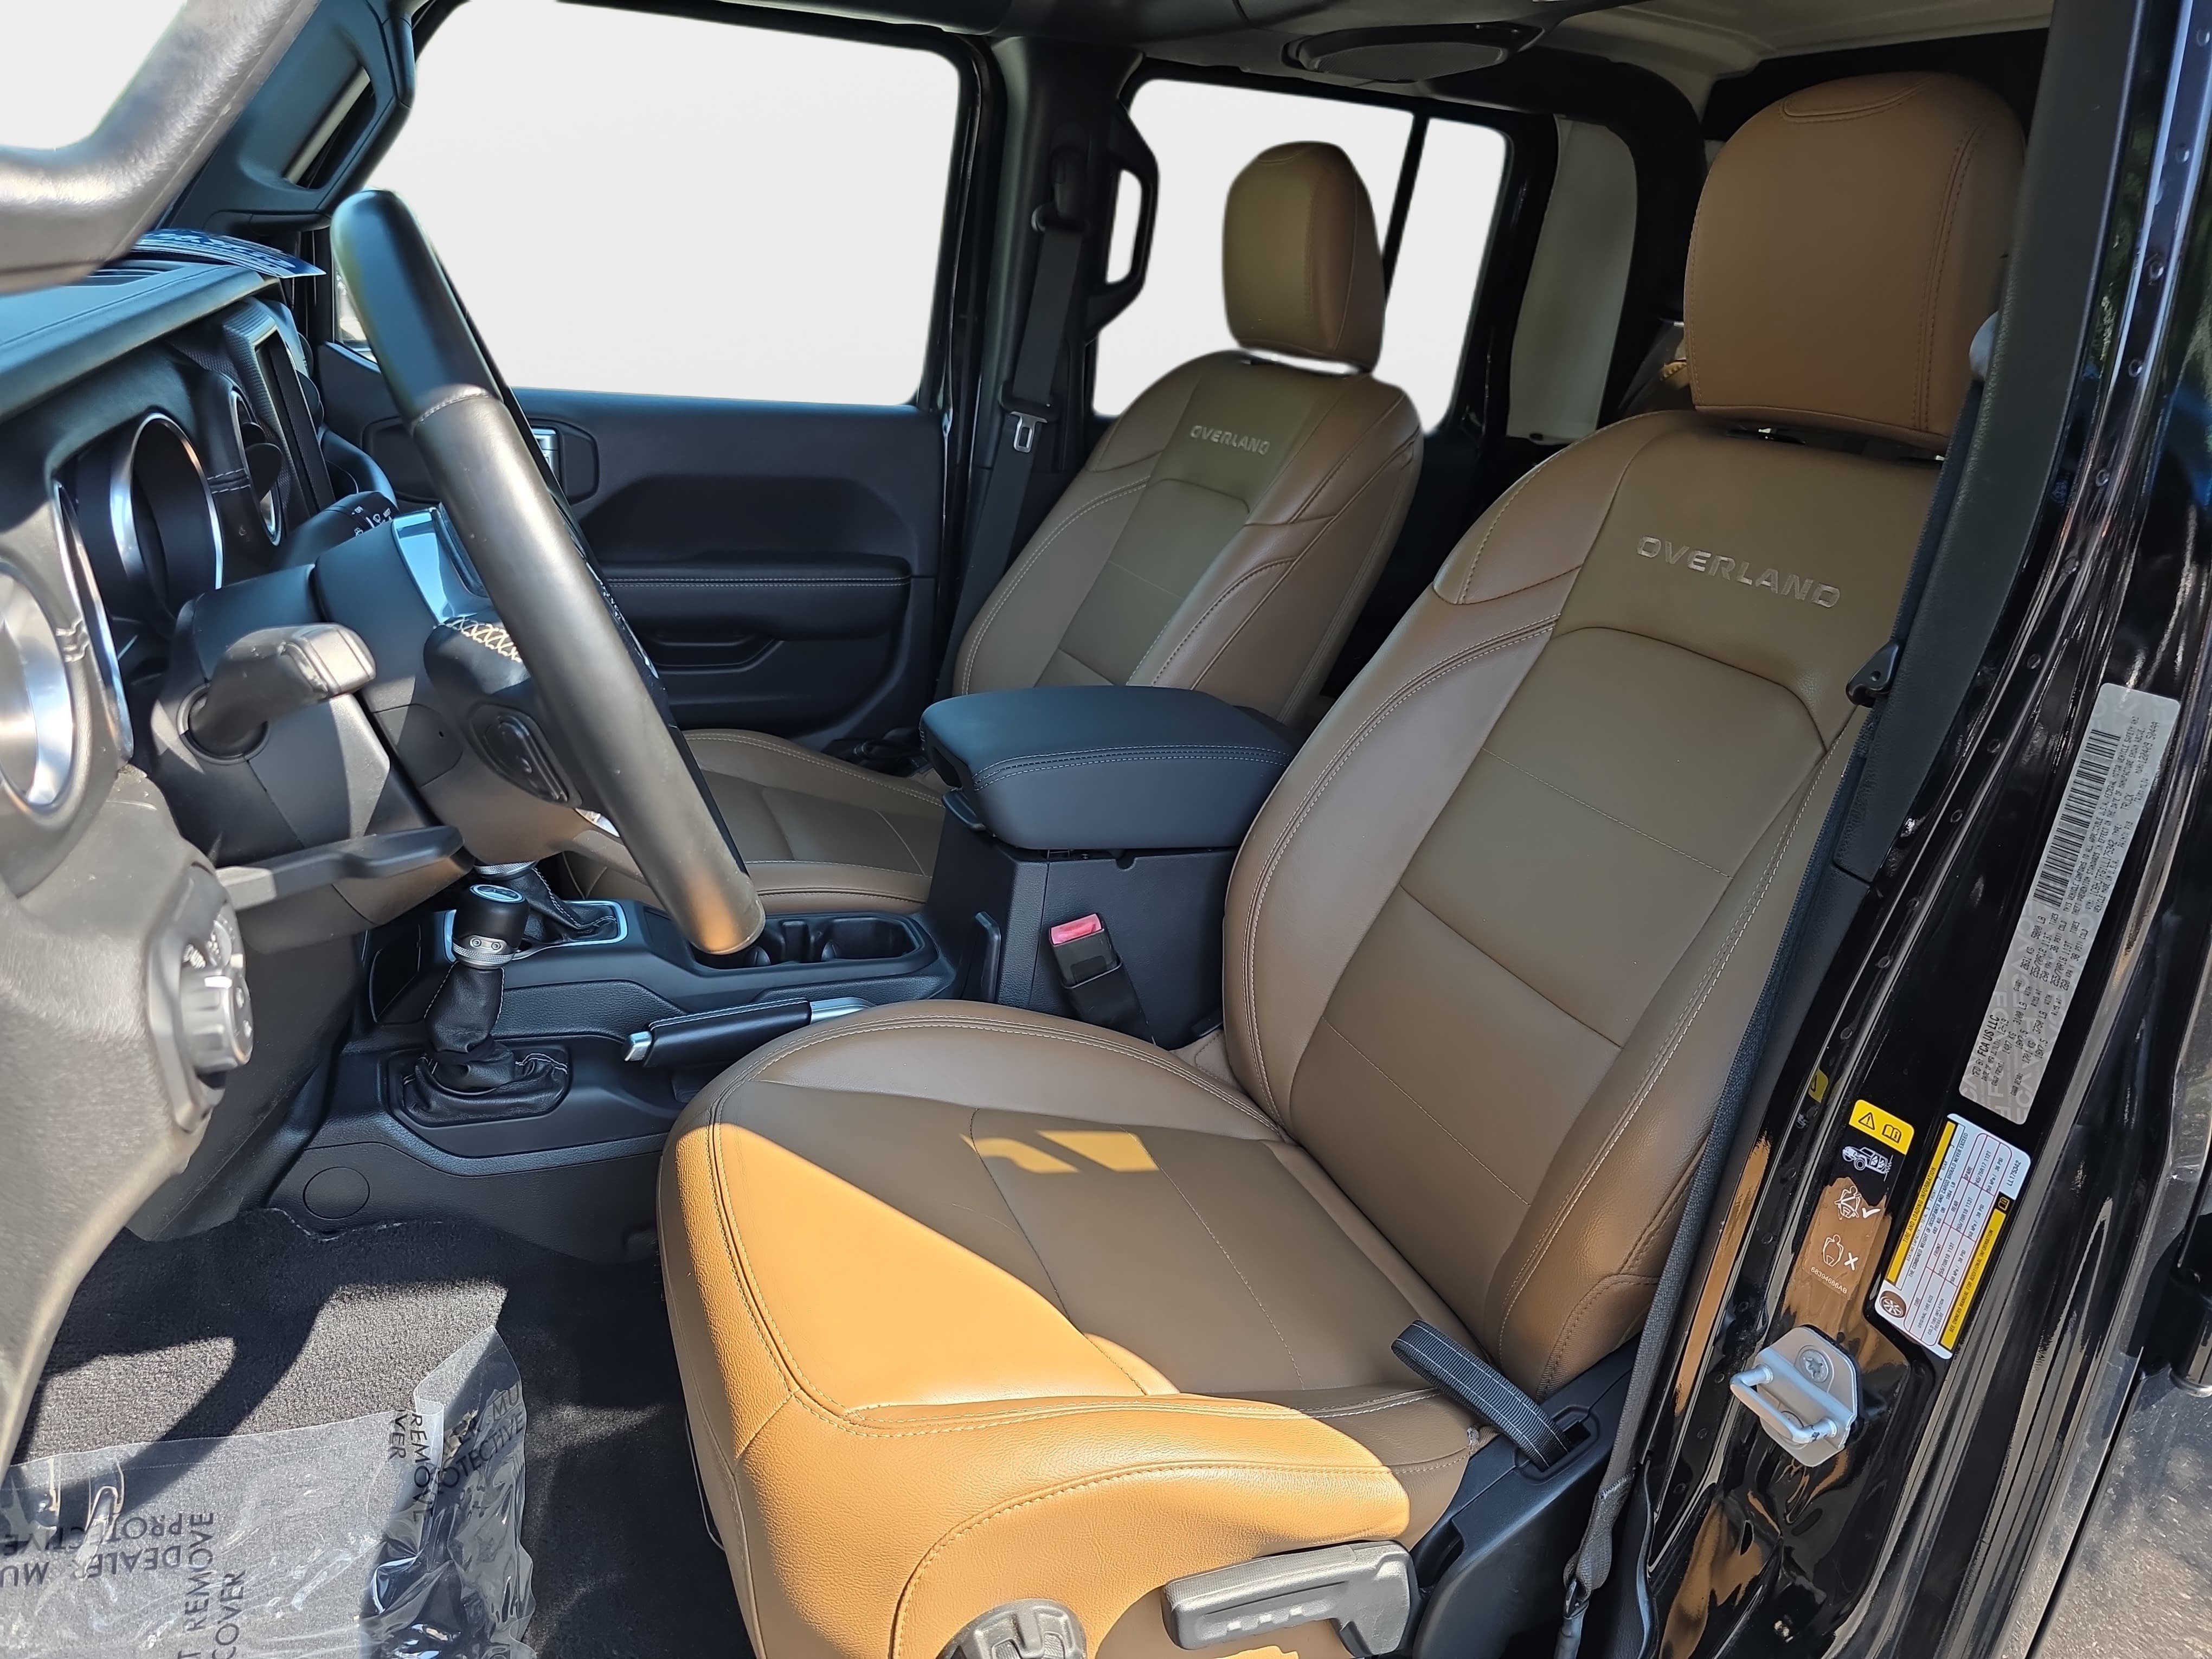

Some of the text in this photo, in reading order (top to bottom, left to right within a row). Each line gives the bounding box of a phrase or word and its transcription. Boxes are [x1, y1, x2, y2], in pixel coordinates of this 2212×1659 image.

[1190, 425, 1271, 455] OVERLAND
[1636, 535, 1841, 608] OVERLAND
[2120, 792, 2135, 811] TRUCK
[2062, 901, 2073, 913] THIS
[2116, 743, 2130, 764] VEHICLE
[2124, 725, 2137, 743] SAFETY
[2093, 894, 2106, 914] VEHICLE
[2036, 915, 2046, 924] LB
[2024, 945, 2035, 955] KG
[2049, 943, 2059, 953] 38
[2069, 951, 2080, 962] 38
[2019, 955, 2031, 970] 2631
[2007, 1030, 2017, 1040] KG
[2017, 1001, 2028, 1011] LB
[2040, 931, 2053, 947] 113T
[2026, 1039, 2036, 1049] KG
[2037, 1009, 2048, 1020] LB
[2061, 940, 2074, 955] 113T
[1982, 1028, 1994, 1041] US
[1986, 1013, 1999, 1030] LLC
[1996, 1017, 2009, 1036] 12-19
[1977, 1040, 1990, 1057] FCA
[1983, 1150, 1991, 1161] 112T
[2006, 1159, 2021, 1187] LL175342
[1902, 1166, 1936, 1243] TIRE AND LOADING INFORMATION
[1911, 1248, 1922, 1270] COMBINED
[1919, 1233, 1928, 1249] WEIGHT
[1928, 1203, 1940, 1227] OCCUPANTS
[1941, 1179, 1950, 1194] CARGO
[1946, 1162, 1956, 1180] SHOULD
[1953, 1148, 1962, 1163] NEVER
[1959, 1132, 1969, 1149] EXCEED
[1933, 1242, 1941, 1257] FRONT
[1950, 1200, 1958, 1212] REAR
[1963, 1165, 1972, 1180] SPARE
[1811, 1266, 1848, 1294] 68394686AB
[1952, 1307, 1962, 1325] OWNERS
[1958, 1290, 1969, 1308] MANUAL
[1969, 1257, 1982, 1282] ADDITIONAL
[1978, 1228, 1994, 1257] INFORMATION
[387, 1409, 408, 1459] VER
[185, 1513, 214, 1632] REMOVE
